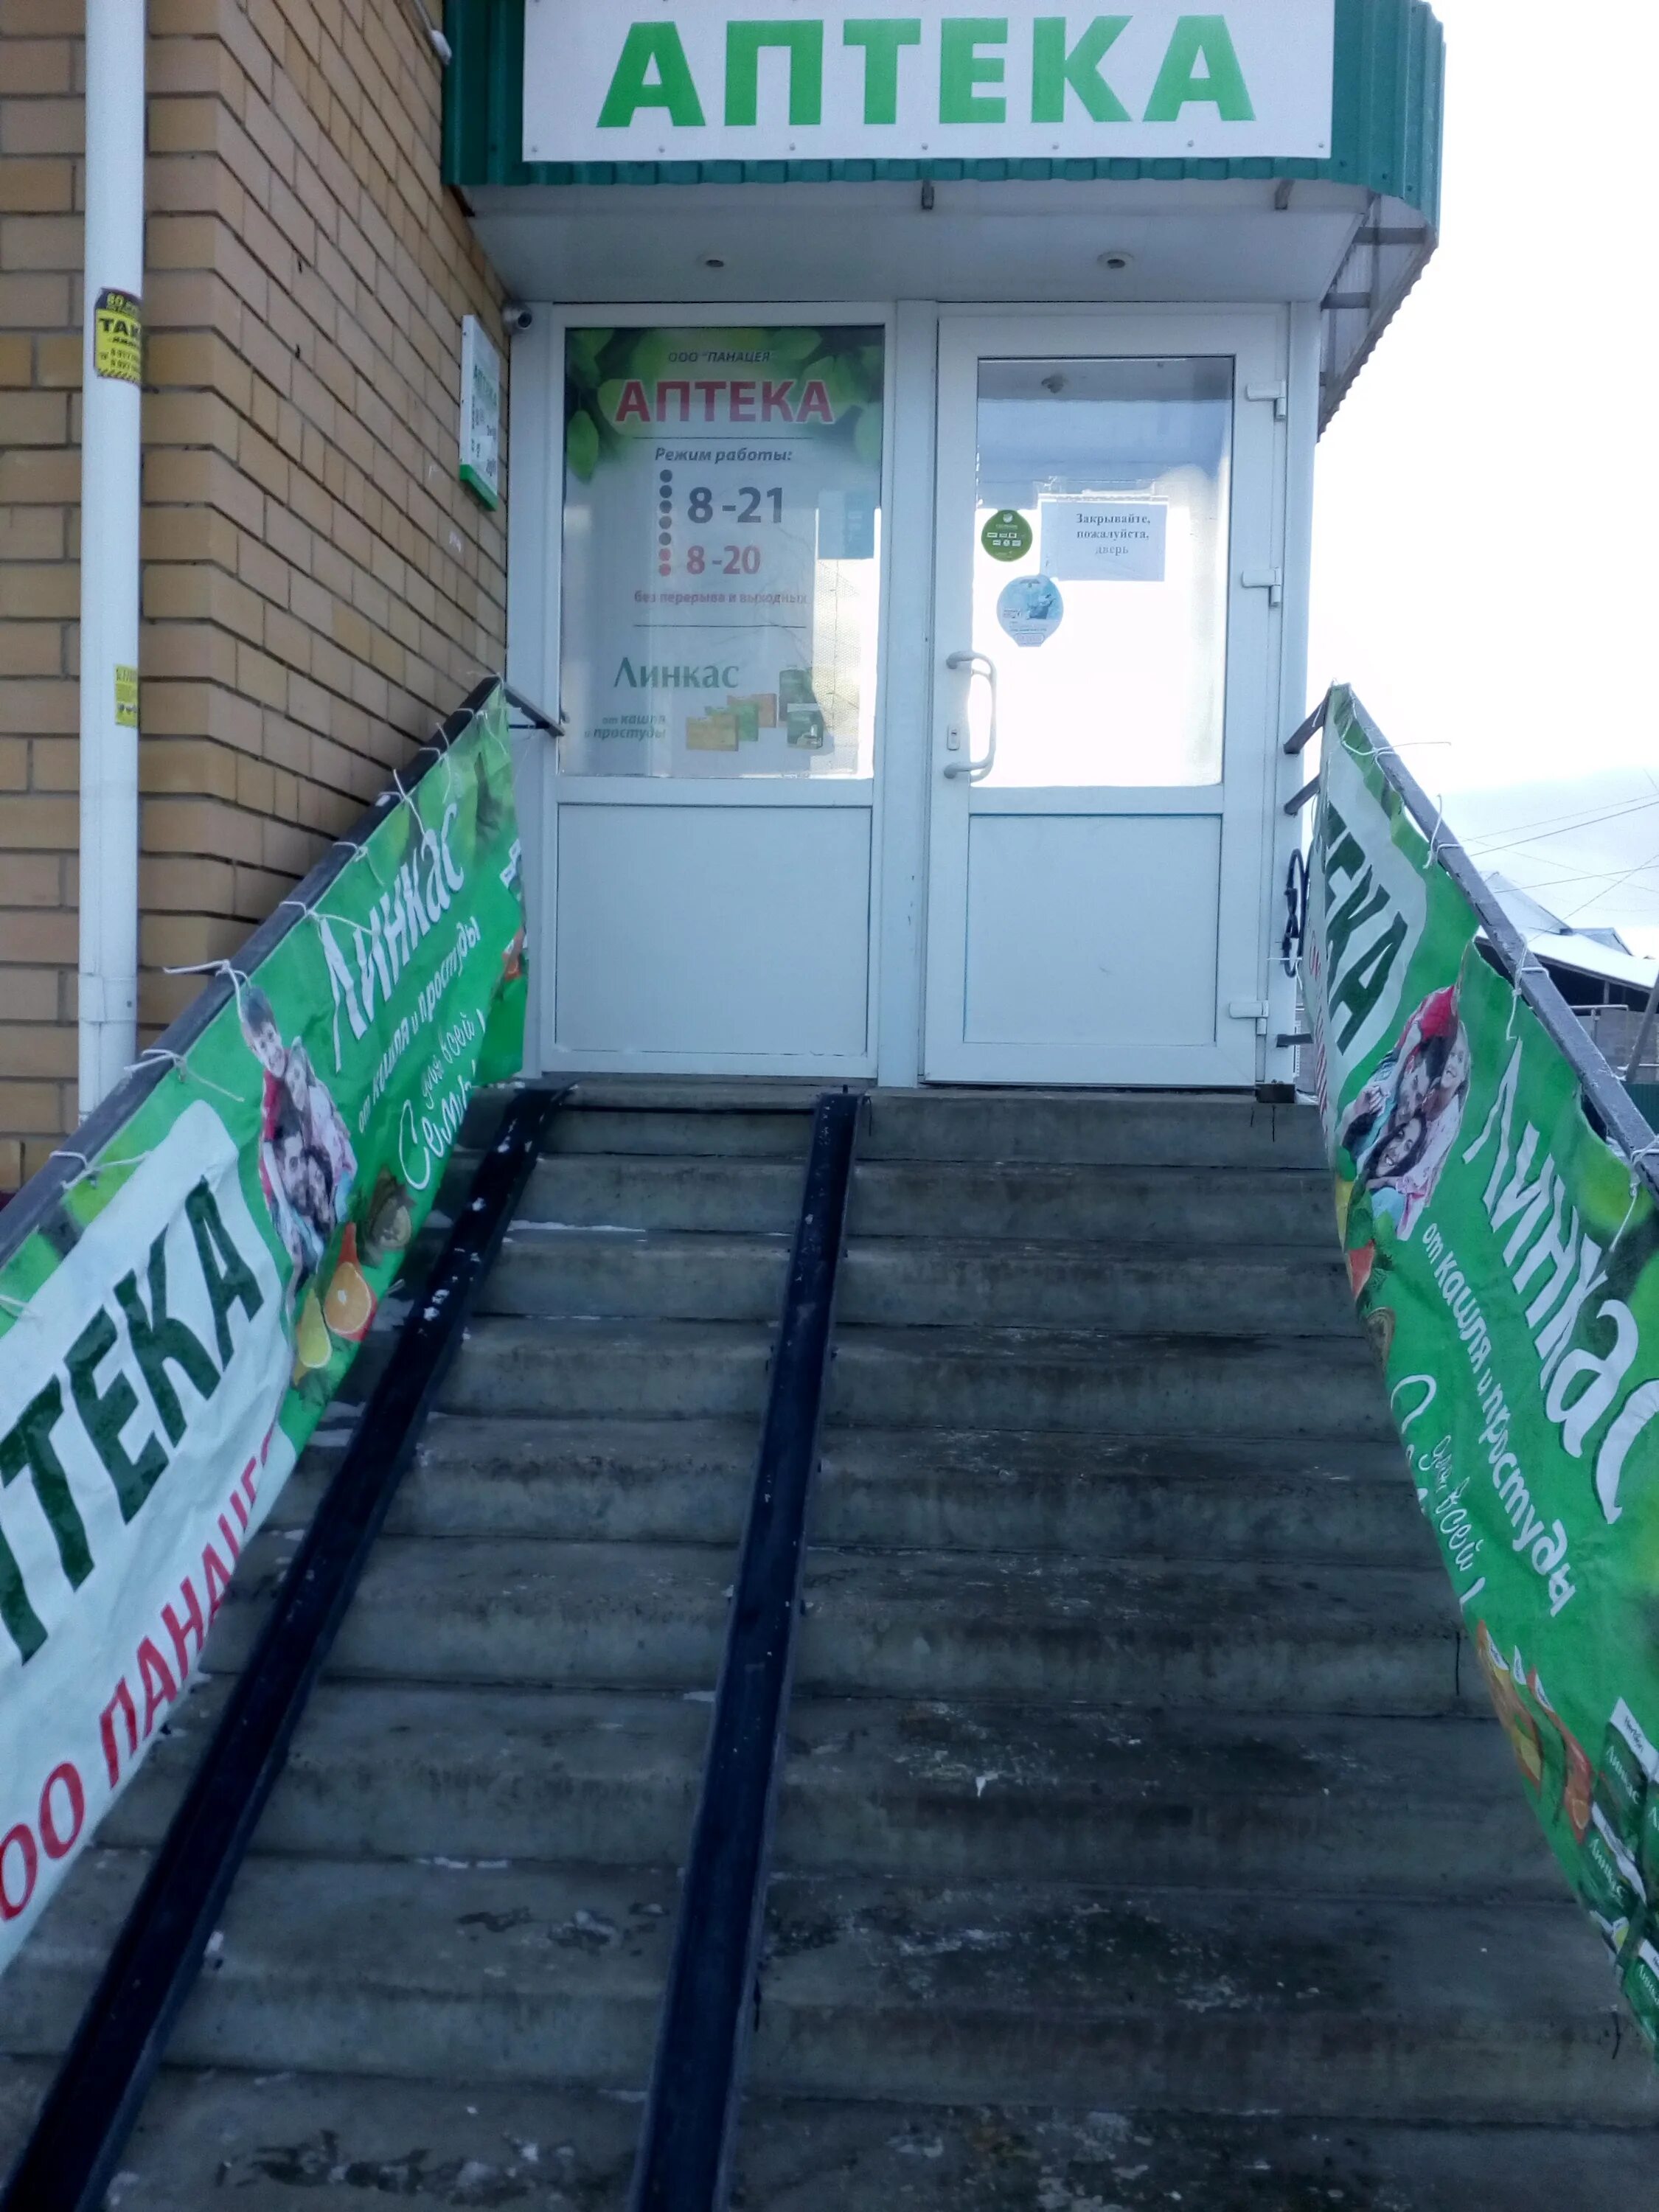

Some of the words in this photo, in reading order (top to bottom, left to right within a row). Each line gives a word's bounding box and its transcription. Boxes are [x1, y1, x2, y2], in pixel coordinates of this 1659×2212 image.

[597, 15, 1256, 128] АПТЕКА
[669, 352, 698, 363] ООО
[615, 380, 834, 423] АПТЕКА
[655, 447, 712, 462] Режим
[714, 448, 793, 465] работы:
[1076, 513, 1151, 525] Закрывайте,
[1076, 529, 1150, 542] пожалуйста,
[1095, 546, 1129, 557] дверь
[634, 591, 655, 603] без
[659, 593, 726, 605] перерыва
[728, 593, 736, 603] и
[613, 657, 740, 689] Линкас
[602, 717, 618, 725] от
[320, 803, 465, 1073] Линкас
[418, 917, 481, 1023] простуды
[1422, 1223, 1444, 1265] от
[1433, 1251, 1492, 1374] кашля
[1477, 1368, 1493, 1397] и
[1478, 1382, 1576, 1617] простуды
